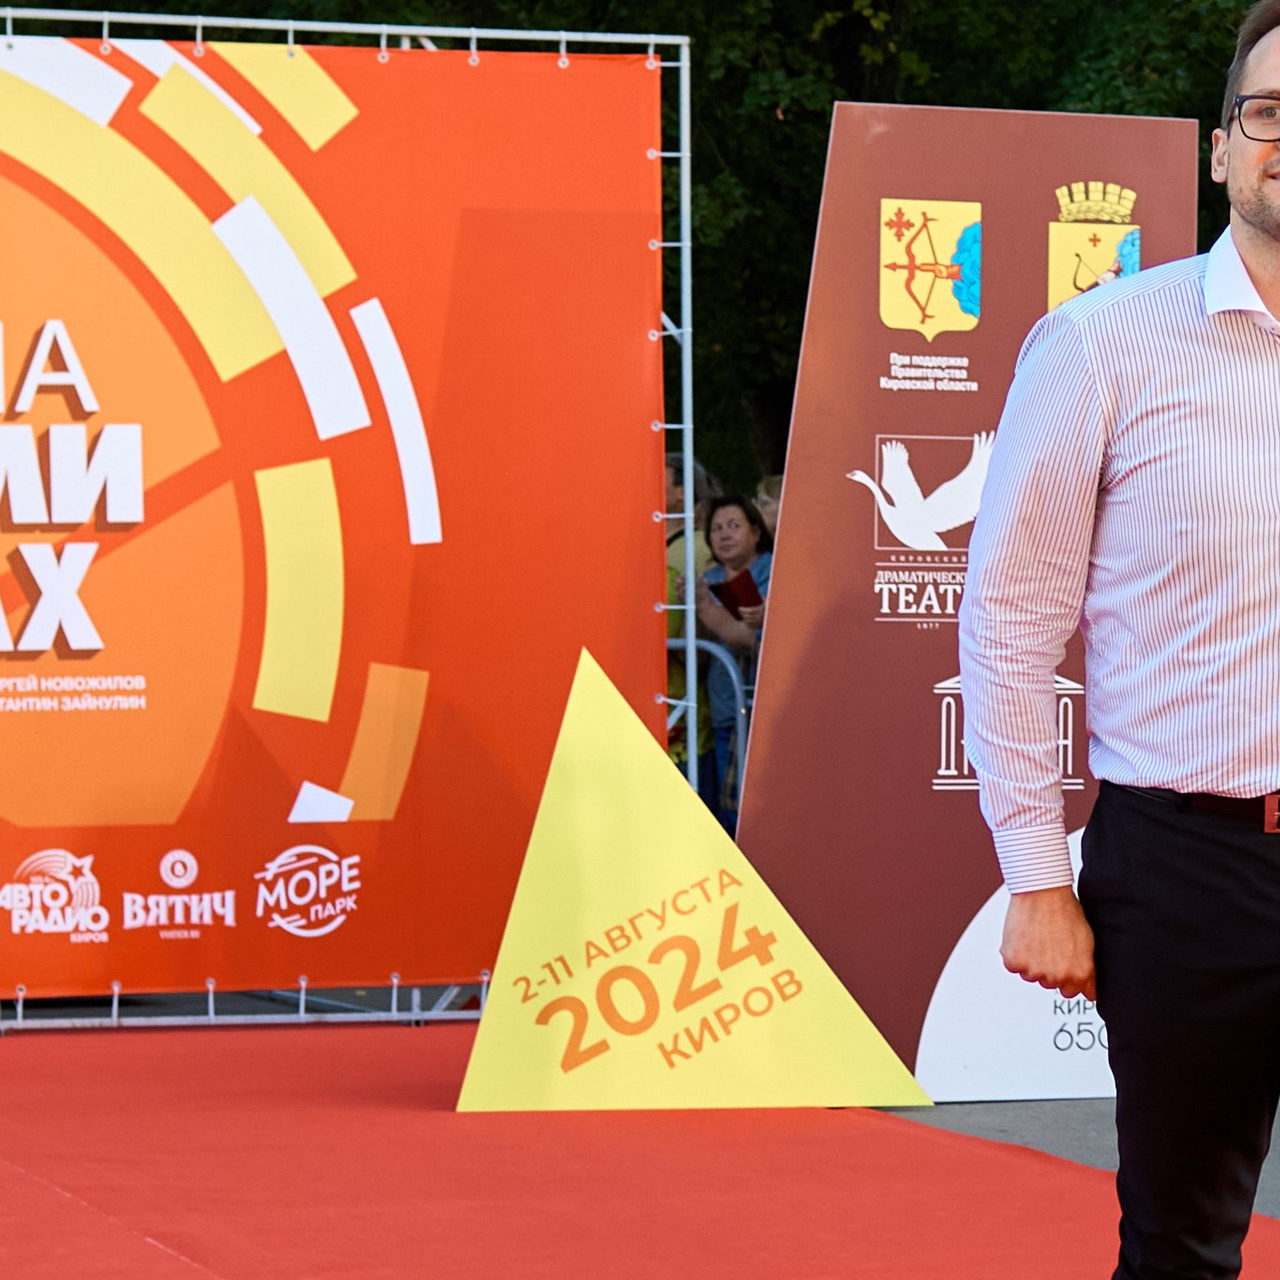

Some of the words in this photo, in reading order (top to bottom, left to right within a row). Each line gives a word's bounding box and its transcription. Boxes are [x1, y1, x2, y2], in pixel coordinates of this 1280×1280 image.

[0, 319, 100, 414] А
[875, 571, 966, 583] ДРАМАТИЧЕСК
[874, 584, 965, 614] ТЕАТ
[41, 675, 147, 691] НОВОЖИЛОВ
[60, 693, 147, 711] ЗАЙНУЛИН
[256, 855, 361, 916] МОРЕ
[12, 906, 109, 933] РАДИО
[123, 890, 236, 929] ВЯТИЧ
[310, 895, 357, 921] ПАРК
[512, 955, 574, 1004] 2-11
[584, 868, 744, 968] АВГУСТА
[535, 902, 778, 1074] 2024
[657, 969, 803, 1069] КИРОВ
